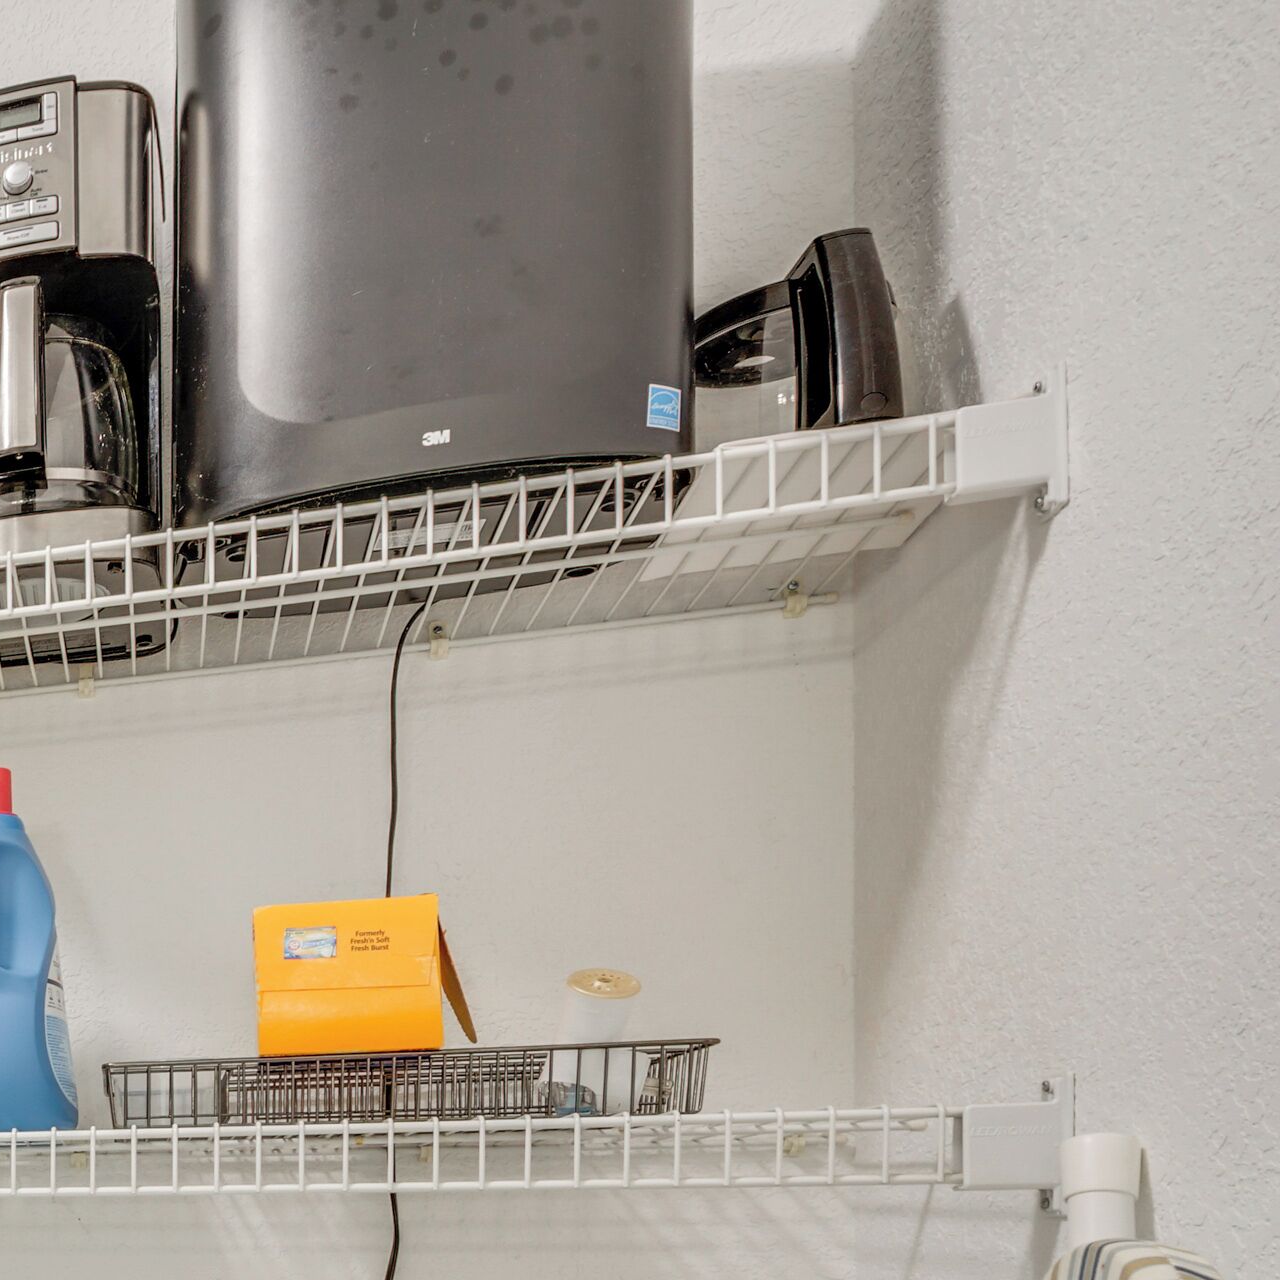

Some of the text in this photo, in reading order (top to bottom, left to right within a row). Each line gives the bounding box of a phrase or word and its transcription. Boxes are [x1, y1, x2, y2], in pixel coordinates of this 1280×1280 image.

[422, 429, 450, 446] 3M
[355, 929, 385, 937] Formerly
[375, 936, 390, 944] Soft
